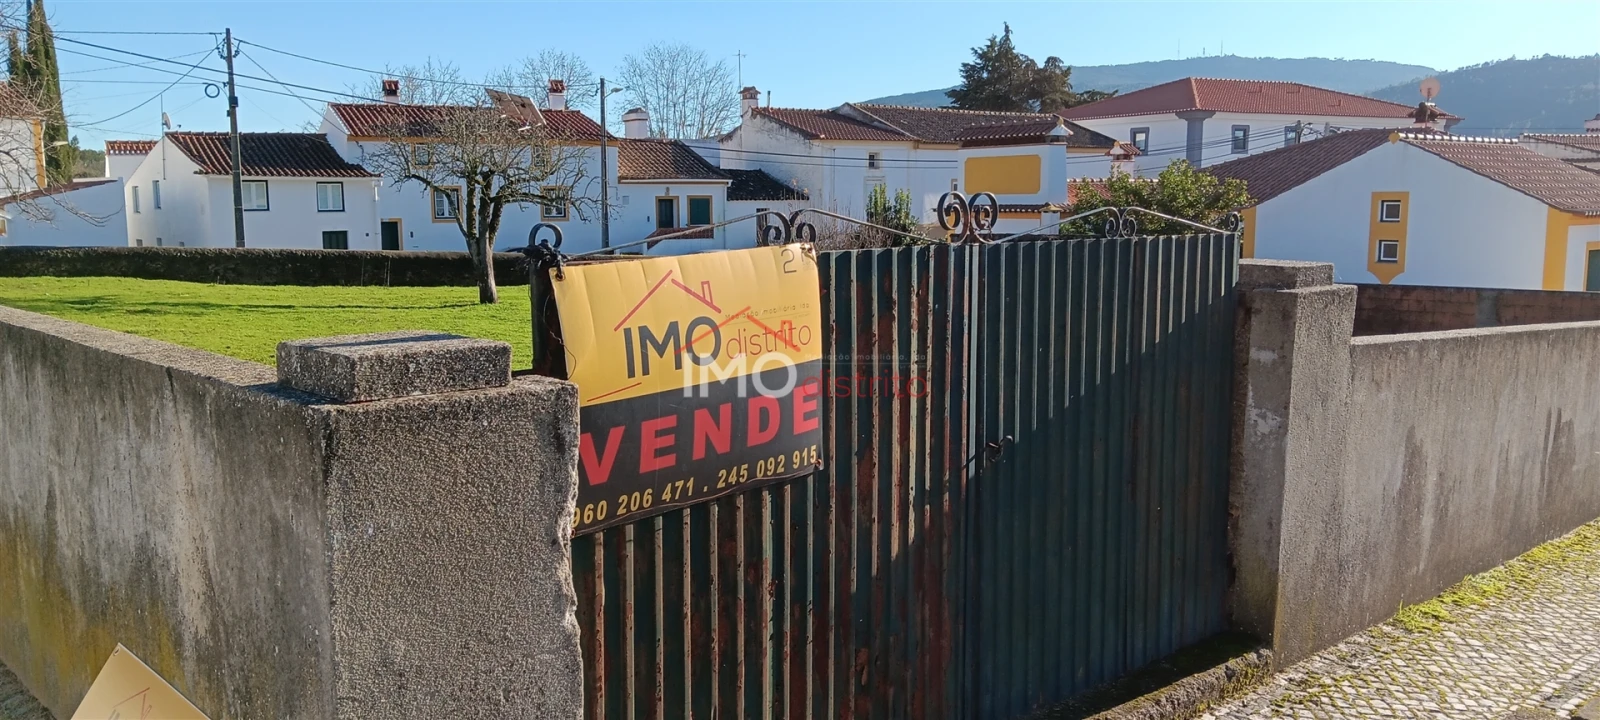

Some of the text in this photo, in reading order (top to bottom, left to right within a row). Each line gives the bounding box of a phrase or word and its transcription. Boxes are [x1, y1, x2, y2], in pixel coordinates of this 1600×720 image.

[623, 315, 812, 379] IMO distrito
[578, 383, 819, 487] VENDE
[572, 500, 607, 528] 960
[617, 488, 653, 516] 206
[661, 477, 694, 502] 471
[717, 465, 748, 488] 245
[756, 454, 786, 479] 092
[792, 445, 818, 470] 915
